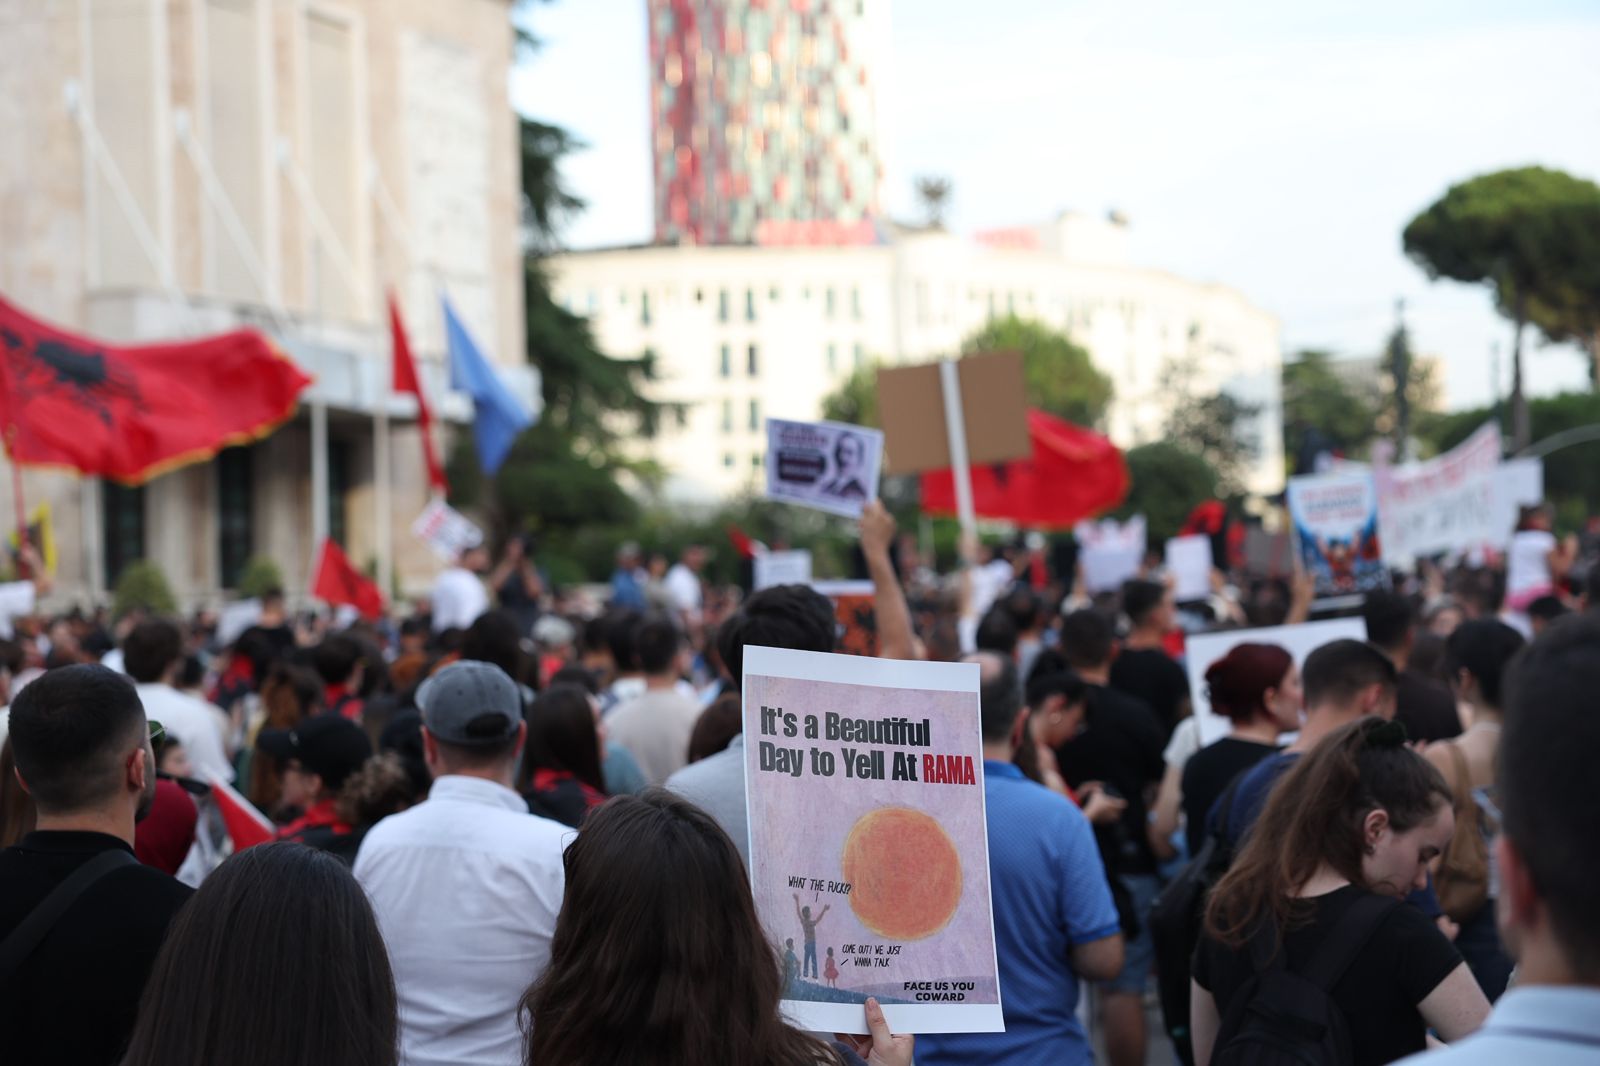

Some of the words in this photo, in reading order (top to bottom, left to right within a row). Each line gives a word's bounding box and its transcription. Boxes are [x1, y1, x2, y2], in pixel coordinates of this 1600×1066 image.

[761, 706, 798, 738] It's
[804, 714, 818, 739] a
[825, 711, 931, 746] Beautiful
[759, 741, 804, 777] Day
[810, 747, 835, 776] to
[841, 748, 885, 780] Yell
[892, 752, 918, 782] At
[923, 754, 976, 785] RAMA
[788, 875, 807, 889] WHAT
[810, 878, 825, 892] THE
[842, 944, 856, 954] COME
[874, 944, 884, 955] WE
[886, 945, 902, 955] JUST
[854, 956, 871, 967] WANNA
[874, 957, 890, 968] TALK
[903, 981, 932, 991] FACE
[934, 981, 949, 991] US
[951, 981, 975, 991] YOU
[915, 992, 965, 1002] COWARD
